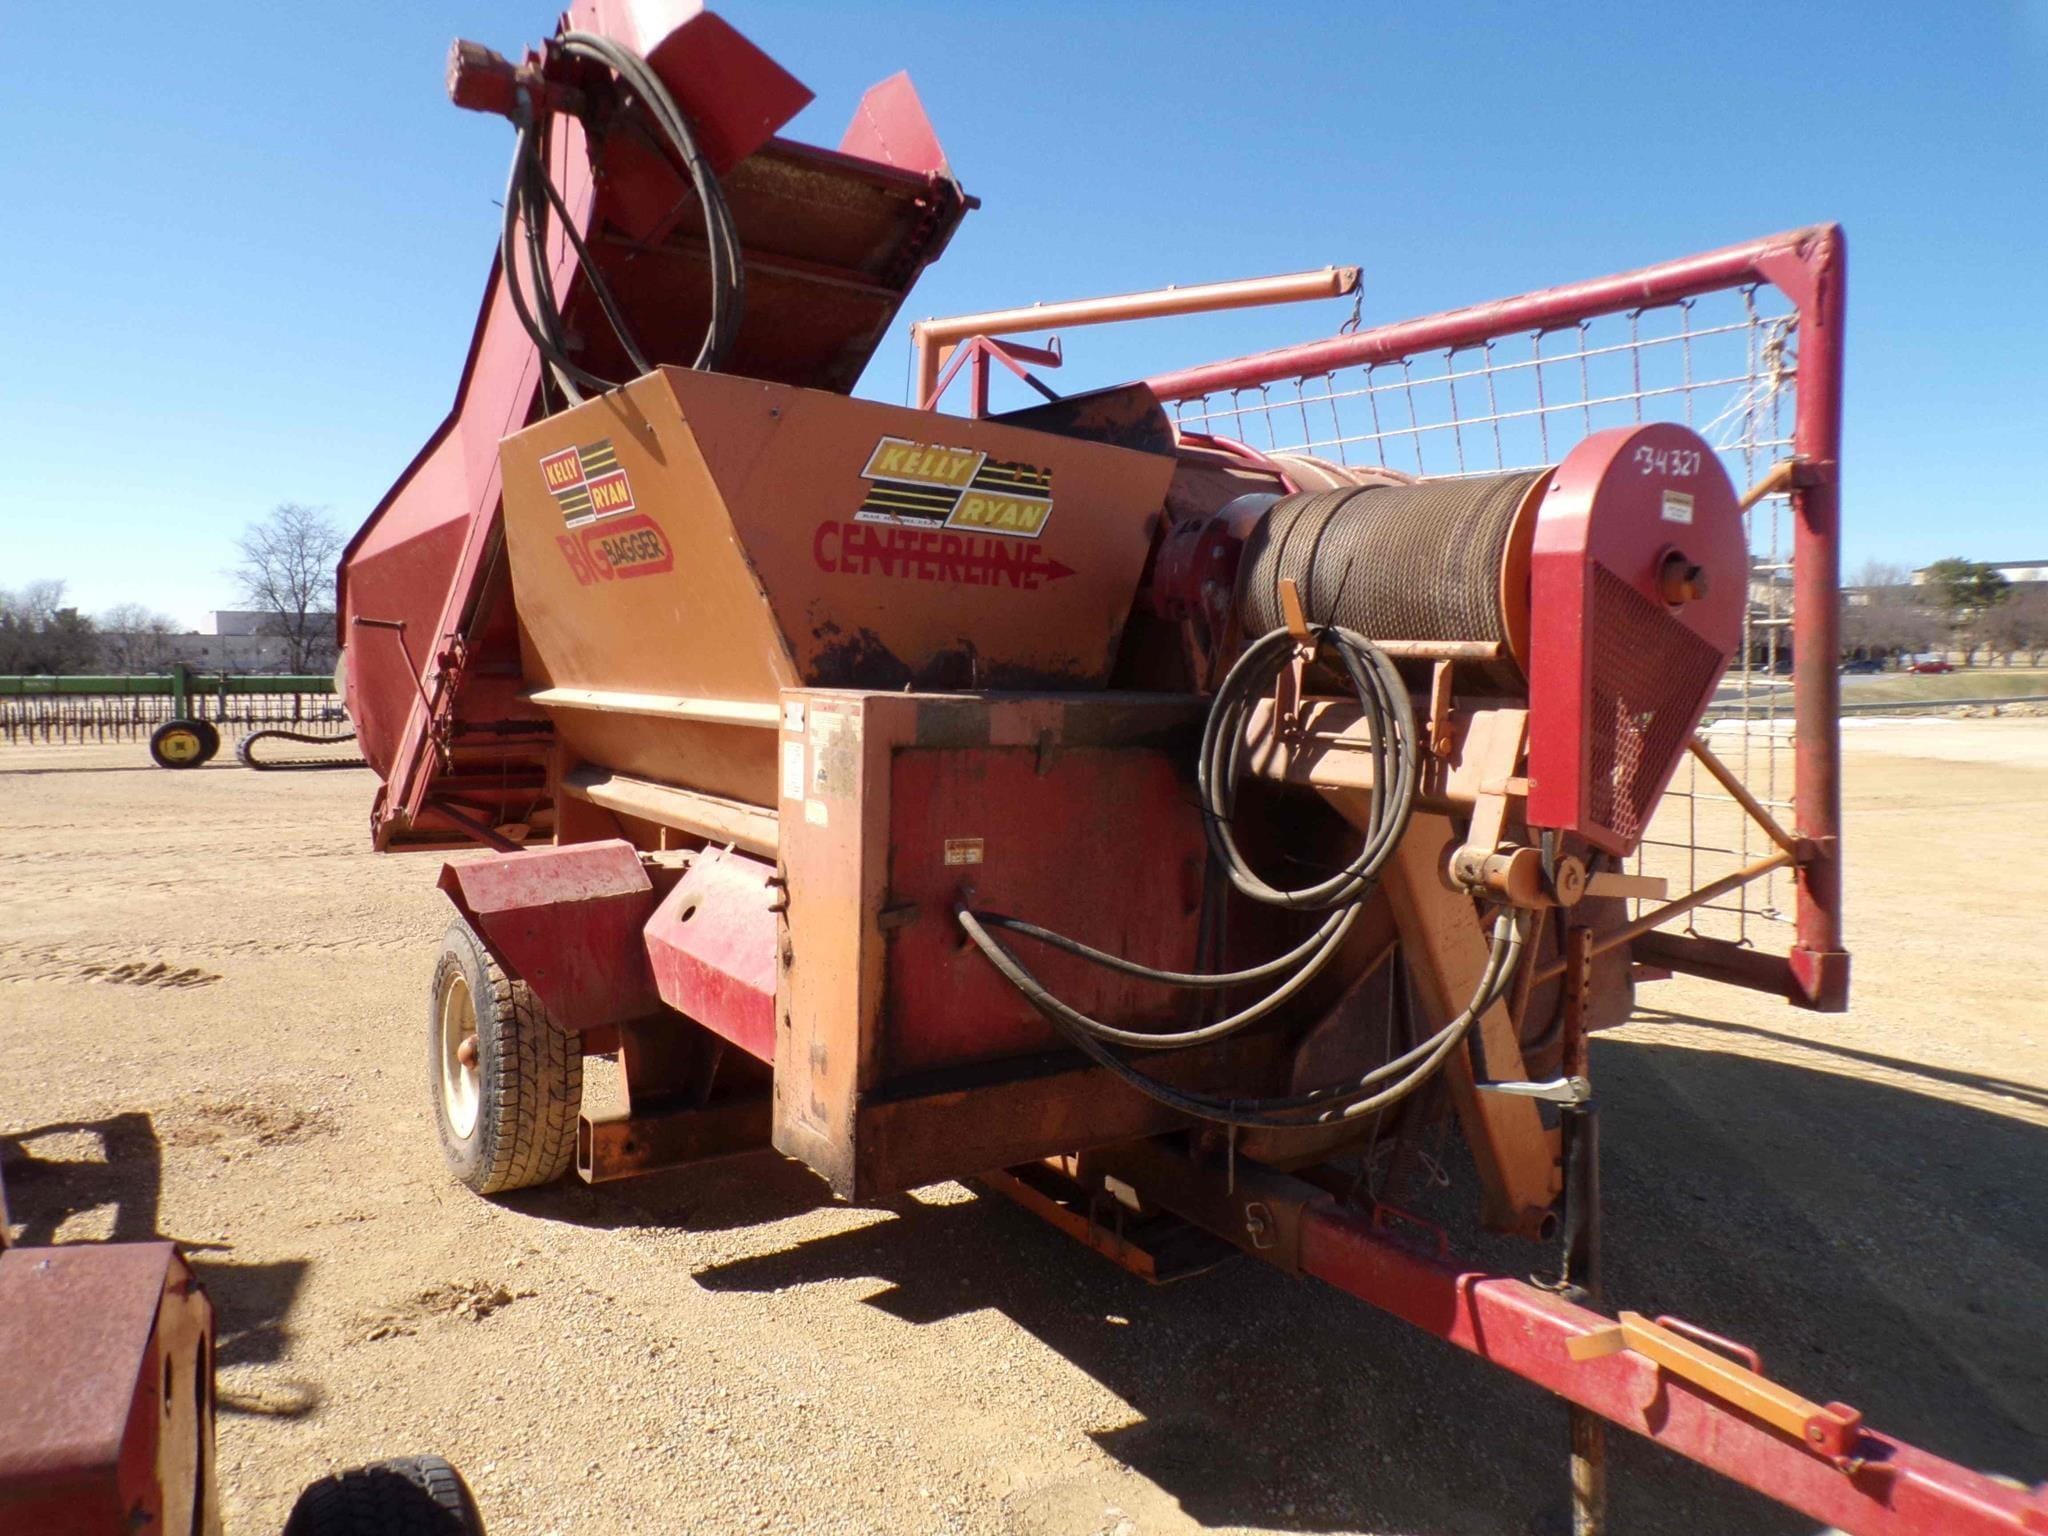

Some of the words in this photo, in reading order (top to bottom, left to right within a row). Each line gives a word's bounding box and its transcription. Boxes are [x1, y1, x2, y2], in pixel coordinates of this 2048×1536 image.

[546, 456, 578, 486] KELLY
[879, 448, 970, 479] KELLY
[592, 479, 628, 509] RYAN
[960, 497, 1042, 528] RYAN
[601, 529, 664, 566] BAGGER
[813, 520, 1042, 590] CENTERLINE
